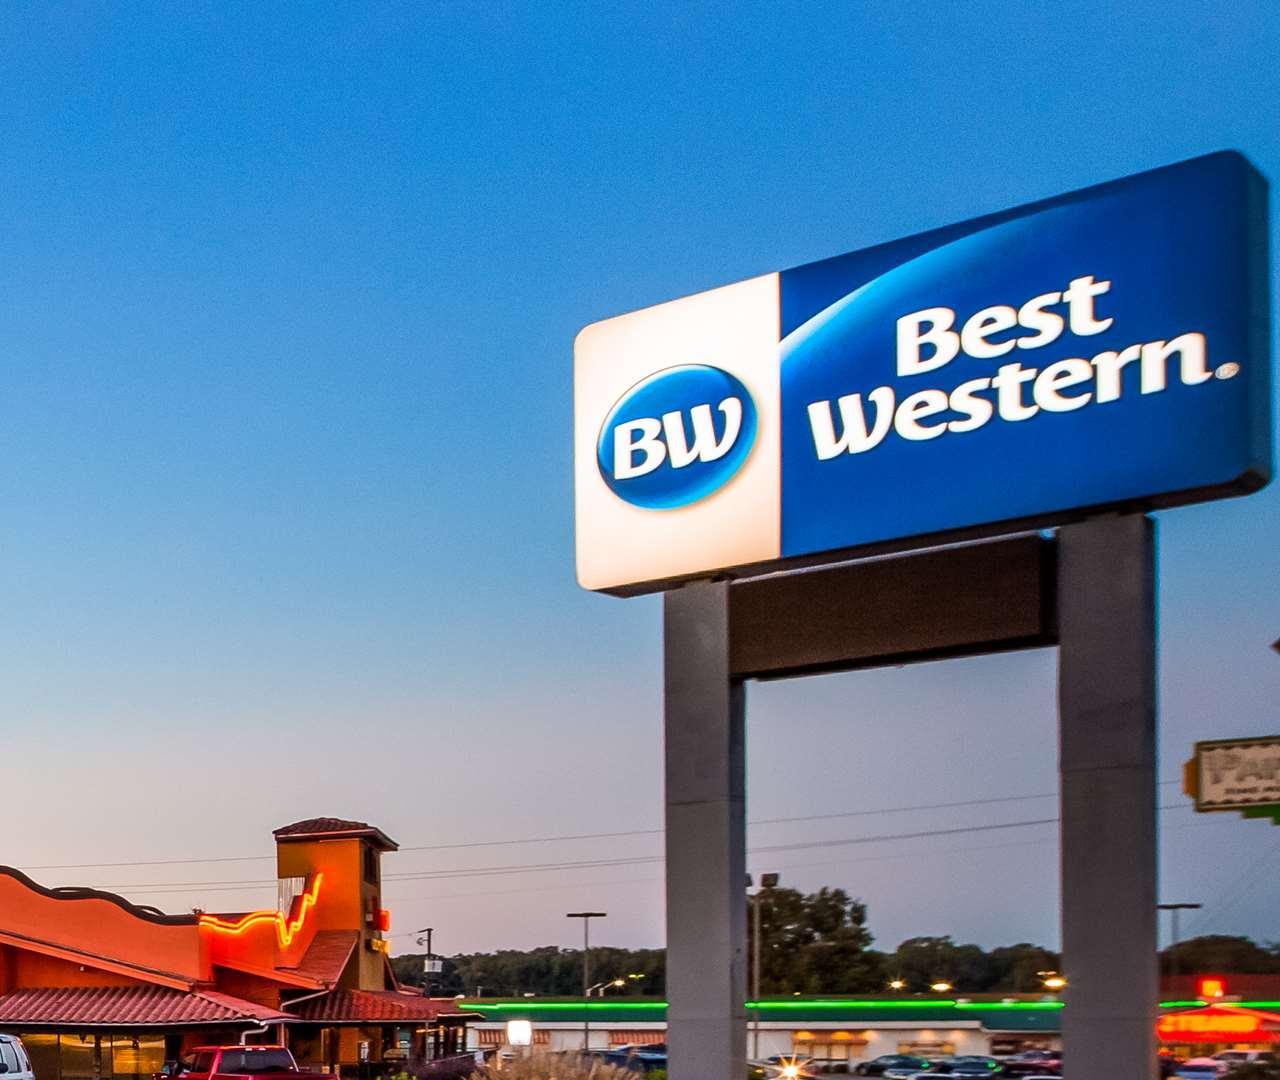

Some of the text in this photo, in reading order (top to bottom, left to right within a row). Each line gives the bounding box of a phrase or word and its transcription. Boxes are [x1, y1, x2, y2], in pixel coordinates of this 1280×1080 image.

[896, 275, 1114, 376] Best
[613, 396, 743, 480] BW
[807, 332, 1214, 461] Western
